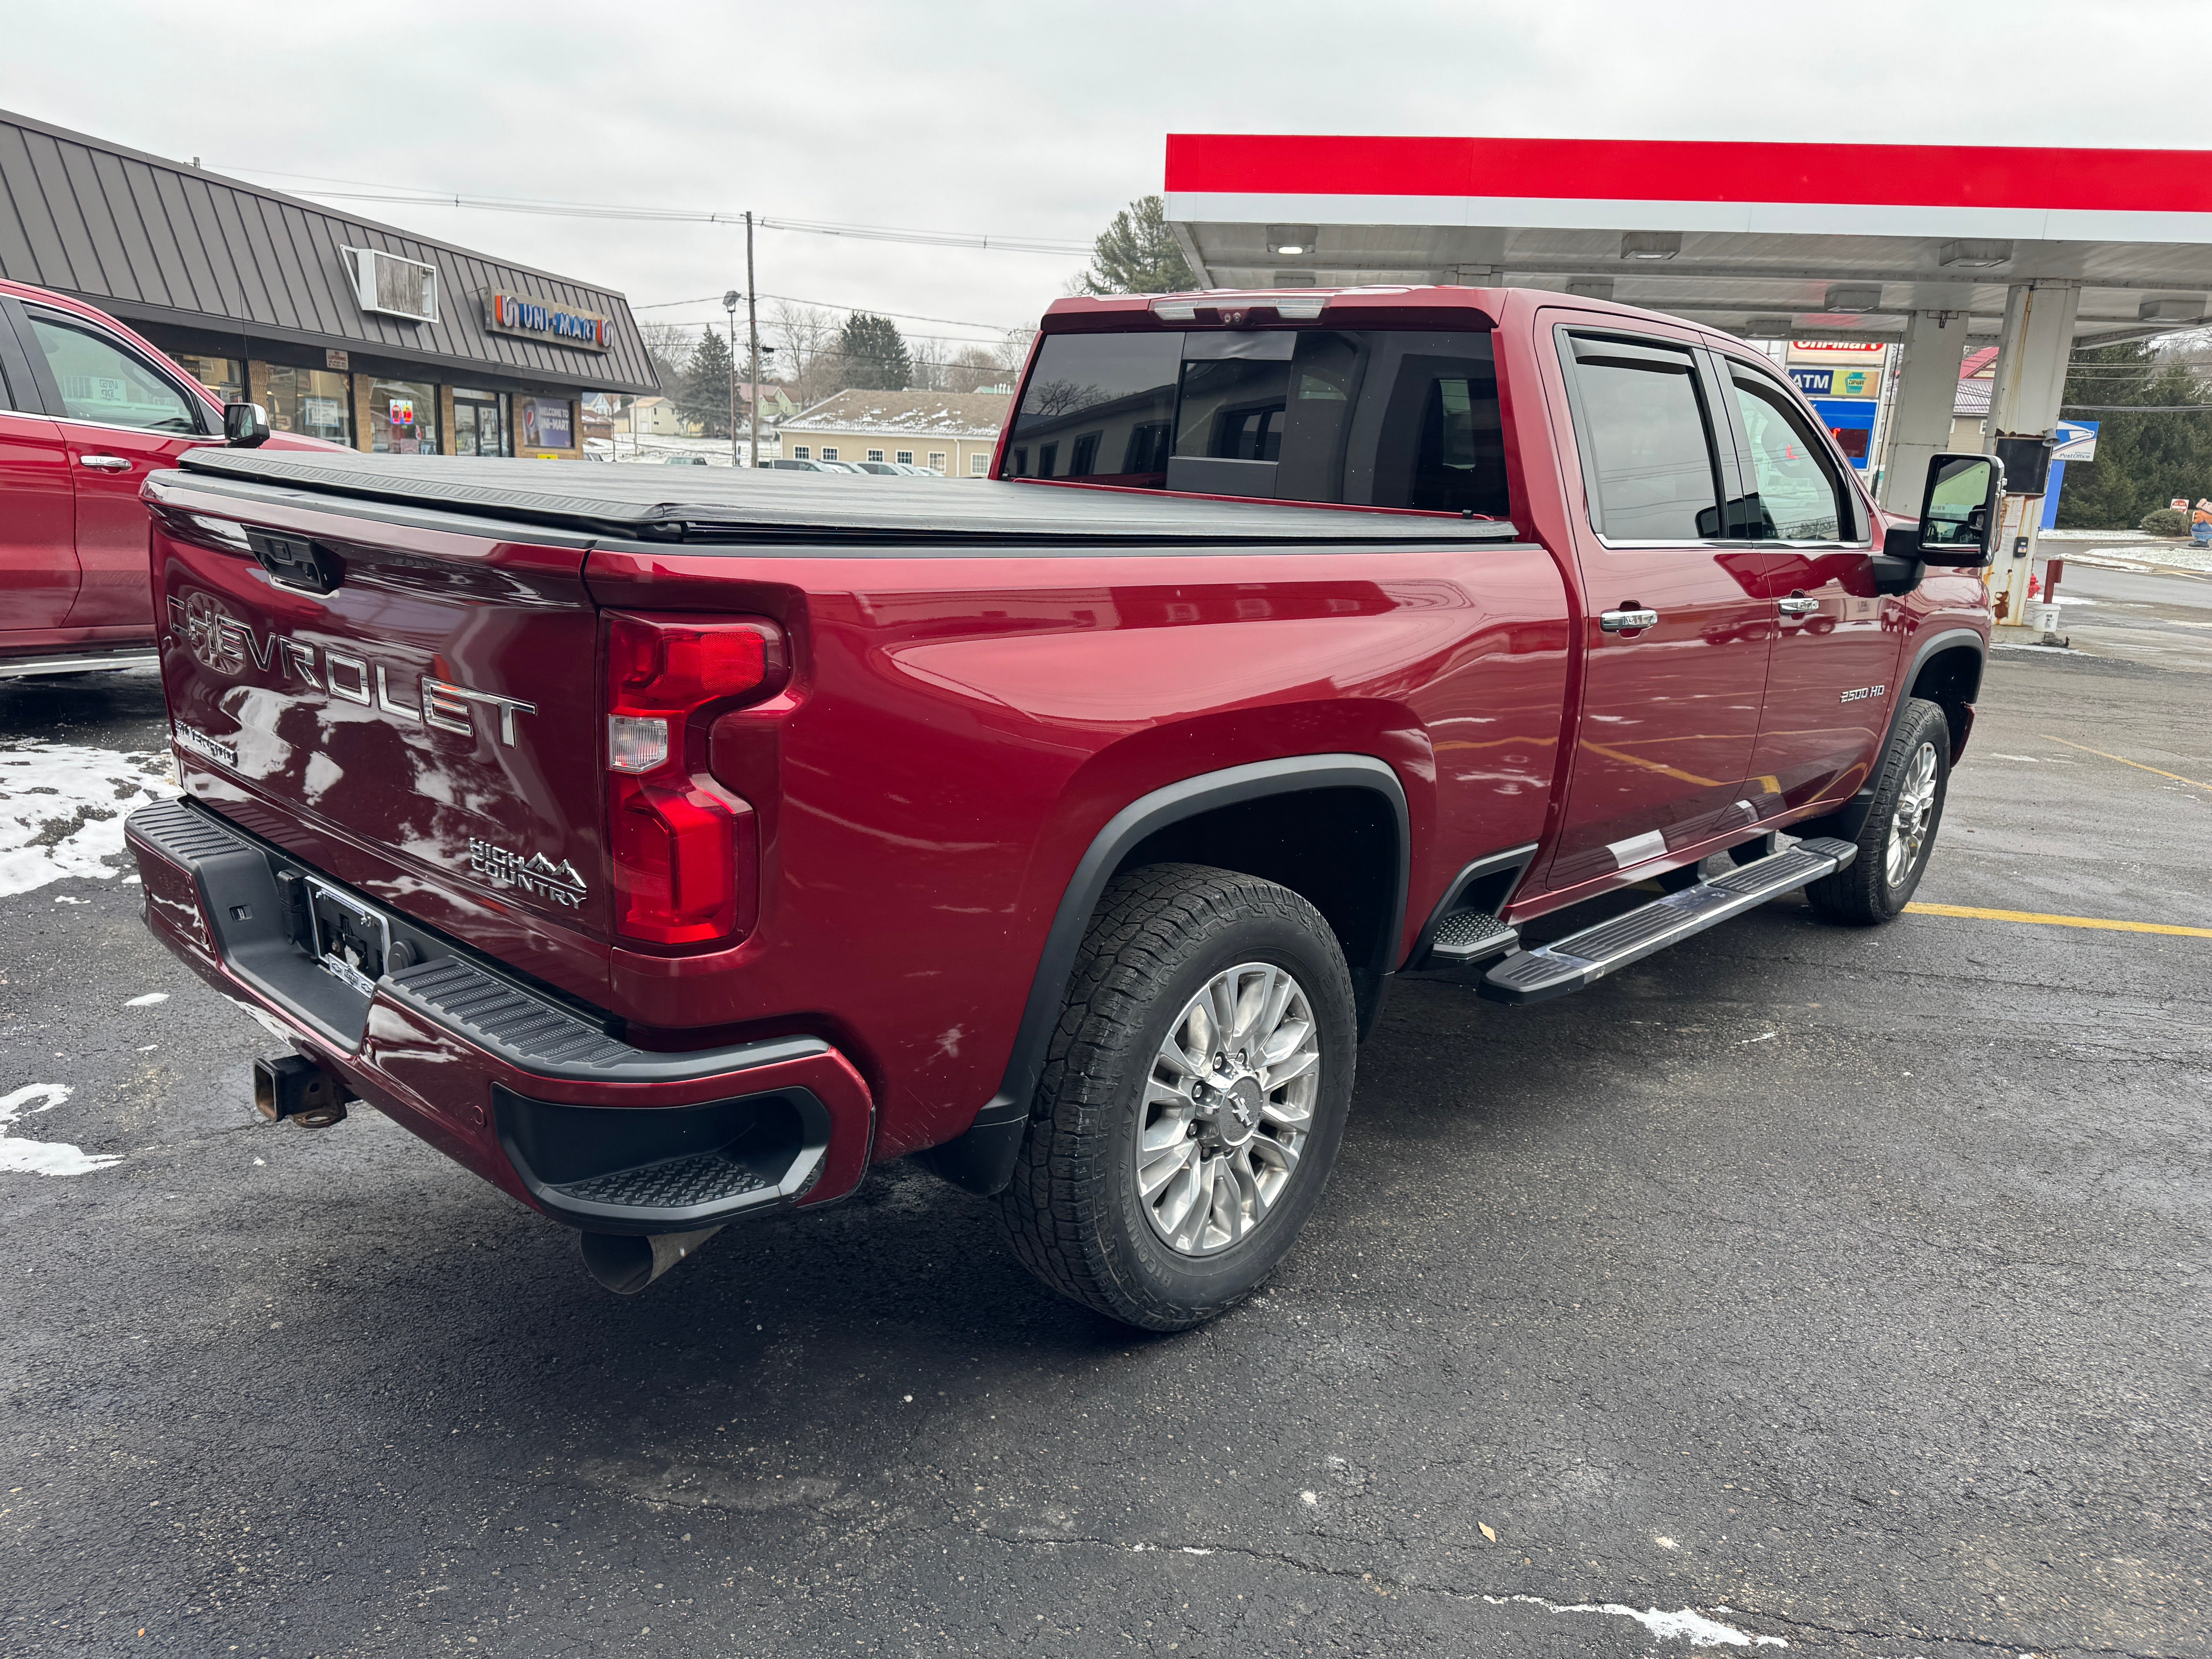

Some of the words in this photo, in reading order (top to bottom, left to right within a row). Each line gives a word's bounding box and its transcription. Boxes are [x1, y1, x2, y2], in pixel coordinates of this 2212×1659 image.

[1793, 374, 1829, 389] ATM
[539, 407, 562, 417] WELCOME
[562, 409, 569, 418] TO
[167, 594, 538, 750] CHEVROLET
[1840, 687, 1869, 703] 2500
[1870, 685, 1885, 697] HD
[469, 837, 524, 871] HIGH
[471, 854, 587, 910] COUNTRY
